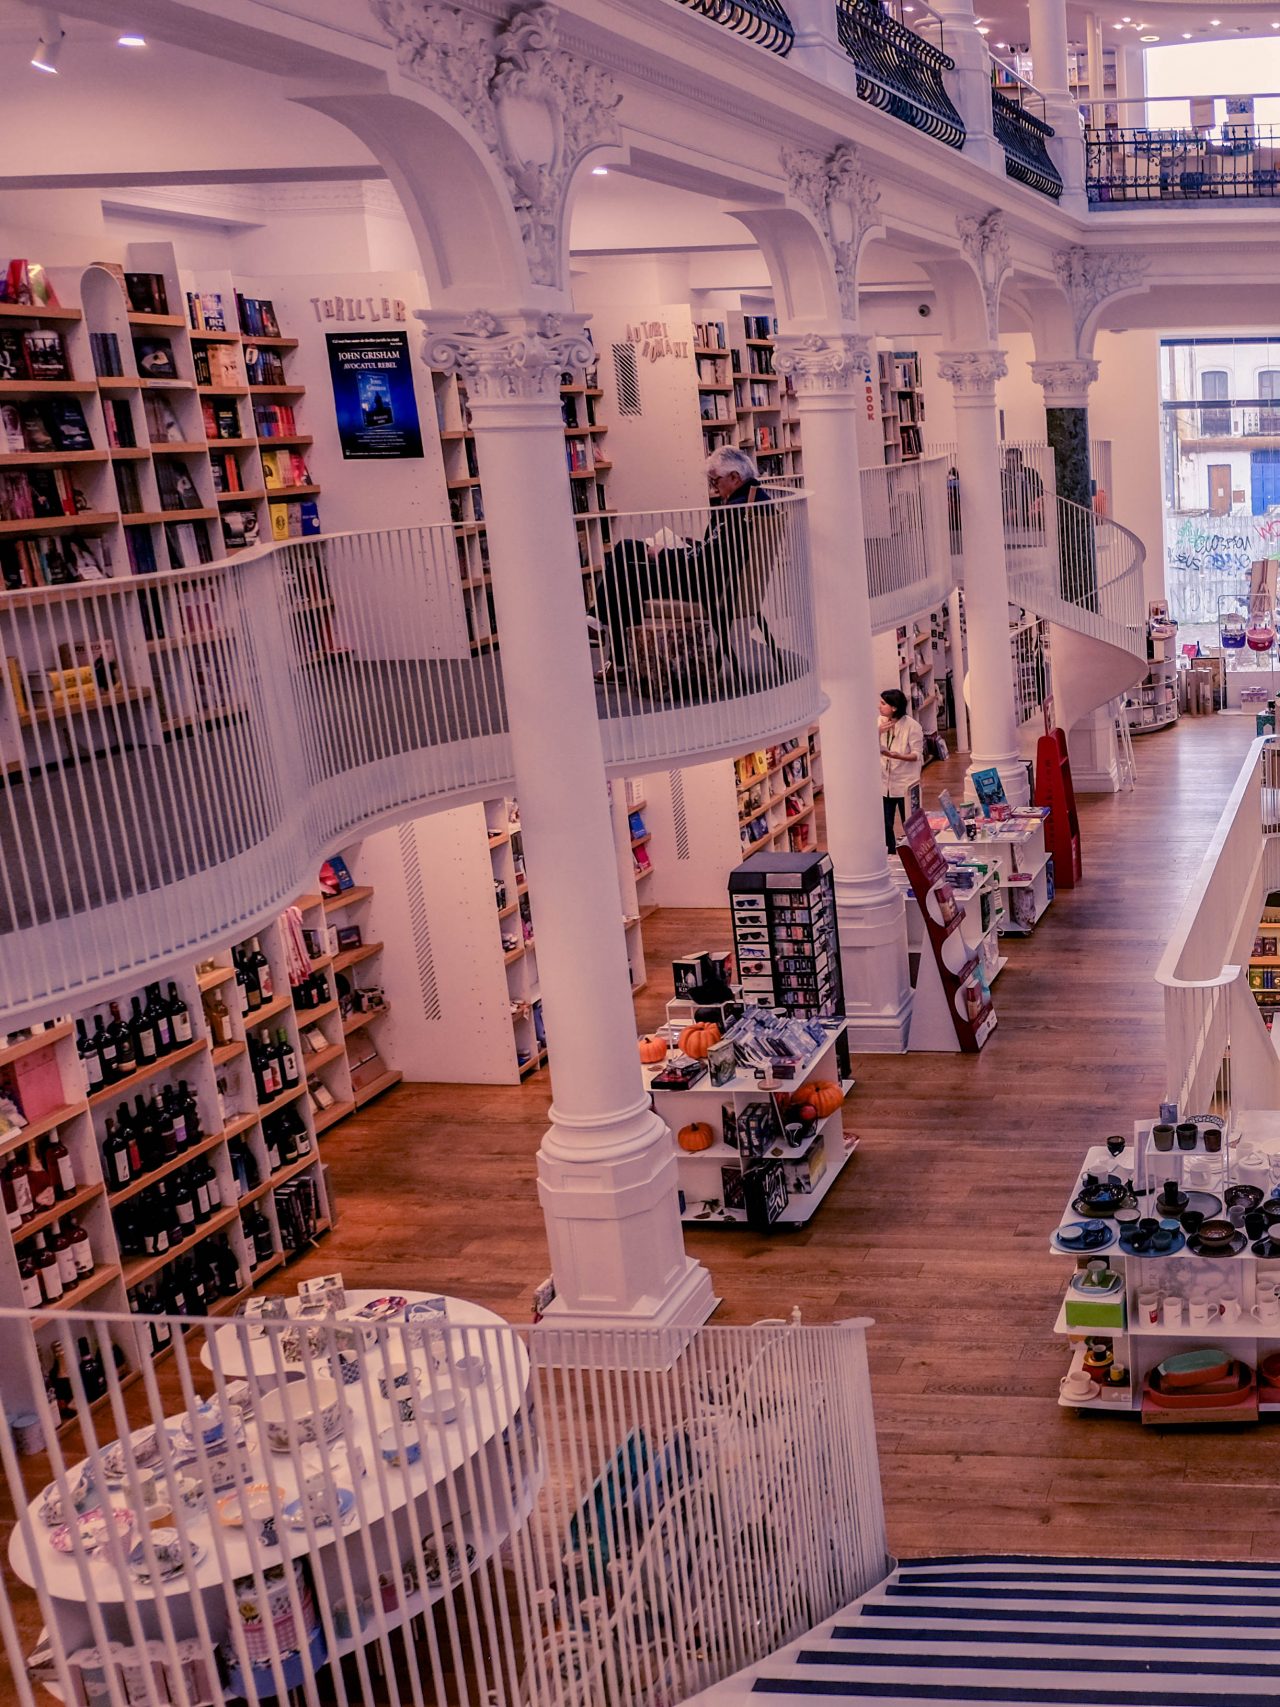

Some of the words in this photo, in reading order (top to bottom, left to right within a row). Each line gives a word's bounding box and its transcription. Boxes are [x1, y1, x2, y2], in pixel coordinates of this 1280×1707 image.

[311, 296, 406, 323] THRILLER
[338, 351, 361, 361] JOHN
[362, 350, 400, 360] GRISHAM
[343, 362, 377, 370] AVOCATUL
[377, 361, 398, 369] REBEL
[865, 386, 875, 421] BOOK
